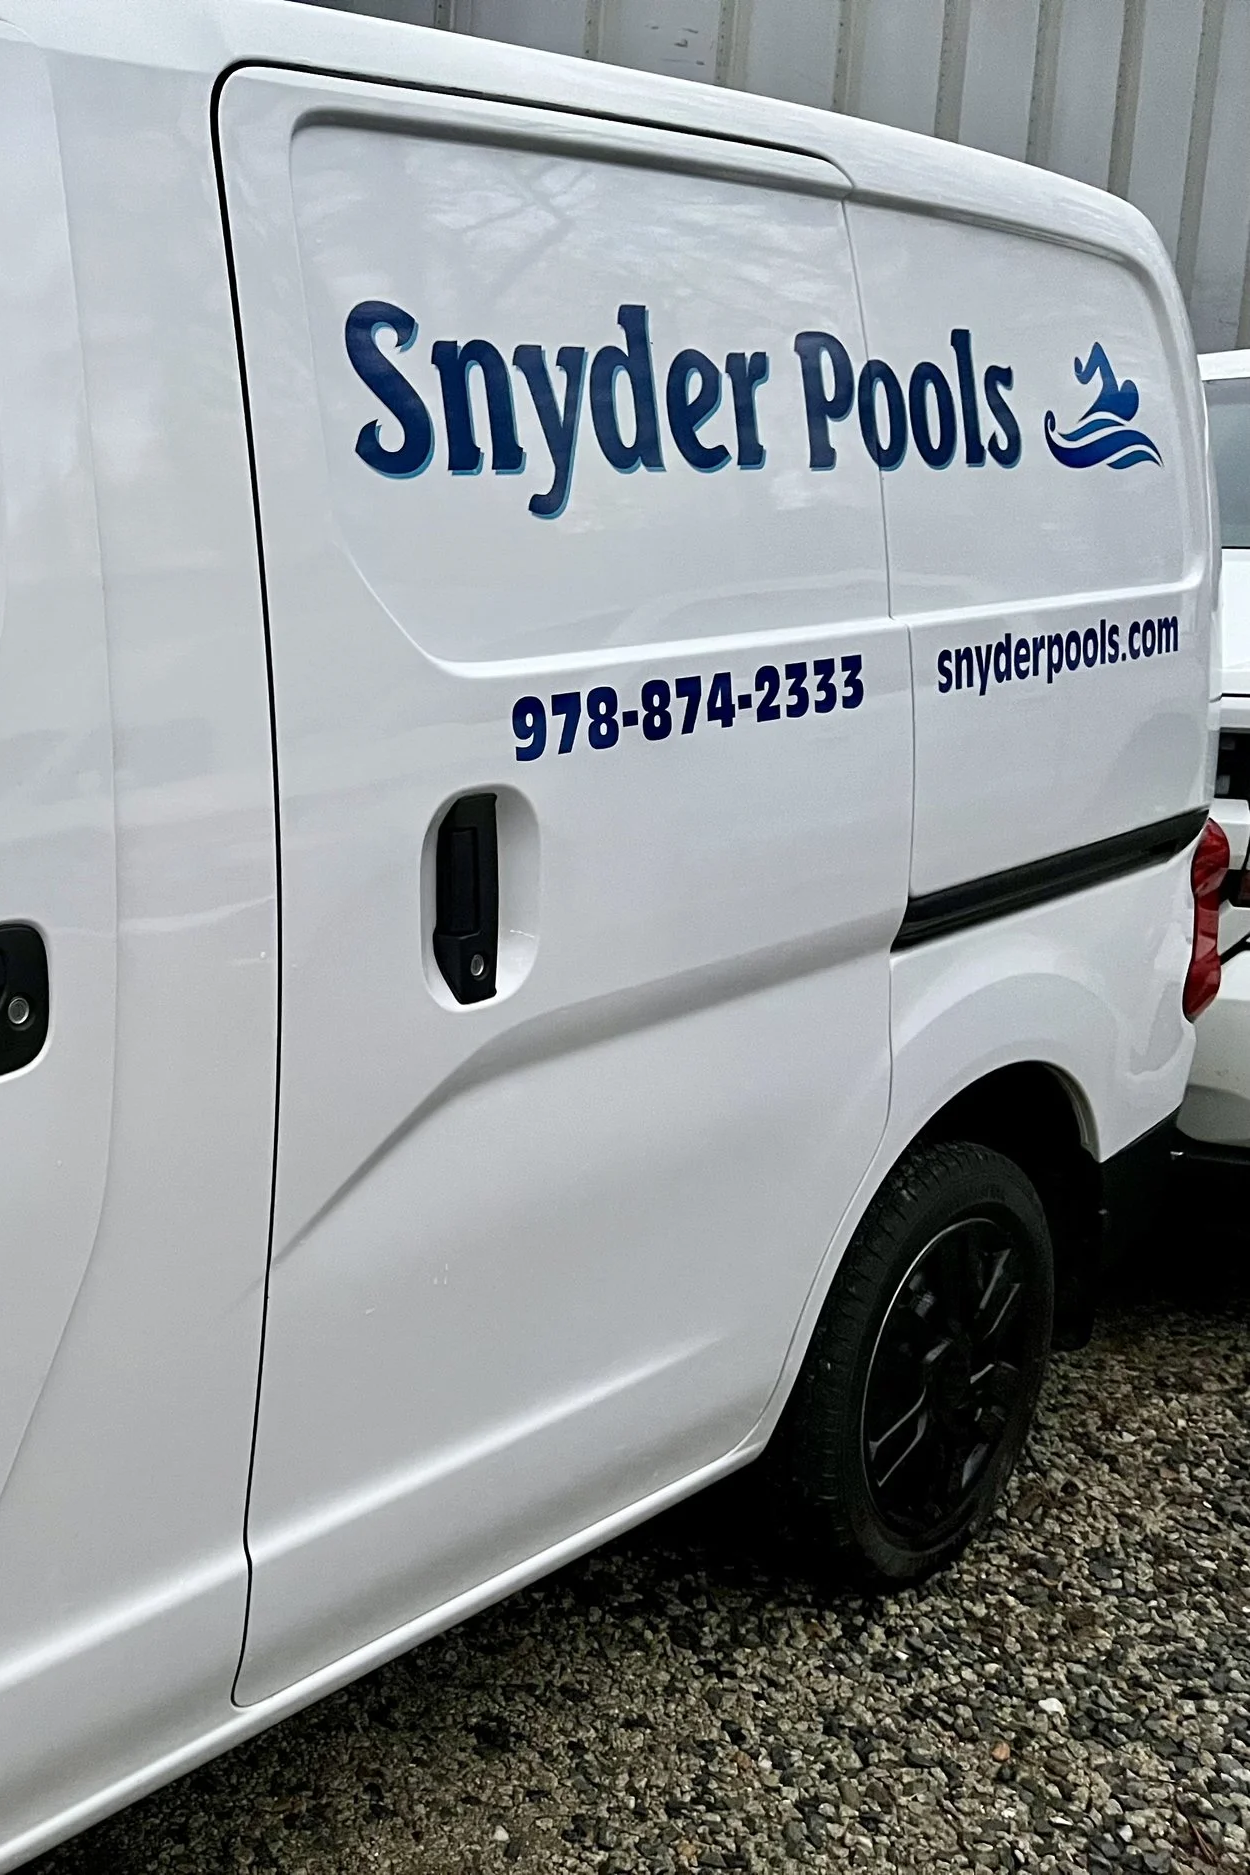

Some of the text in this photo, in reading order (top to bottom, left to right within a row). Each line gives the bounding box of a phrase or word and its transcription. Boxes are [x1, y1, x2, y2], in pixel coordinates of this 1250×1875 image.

[345, 300, 1022, 520] Snyder Pools
[512, 654, 864, 762] 978-874-2333
[937, 615, 1179, 696] snyderpools.com
